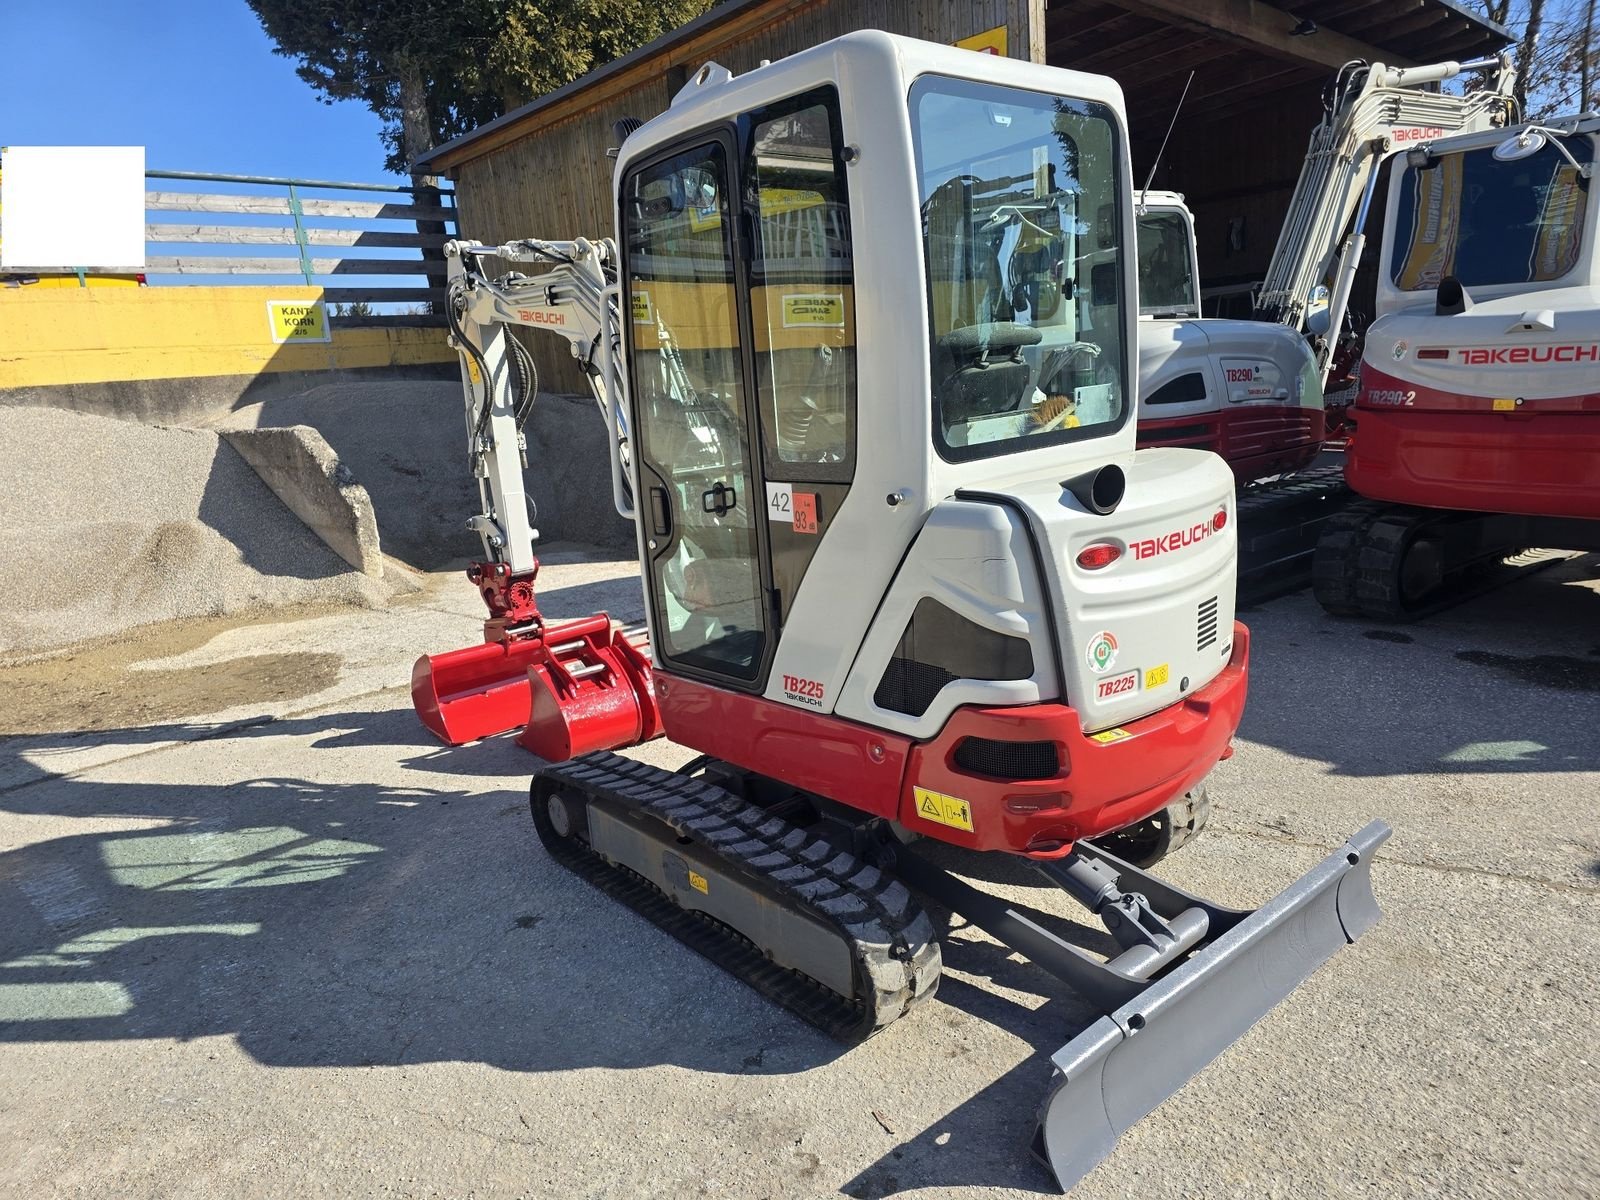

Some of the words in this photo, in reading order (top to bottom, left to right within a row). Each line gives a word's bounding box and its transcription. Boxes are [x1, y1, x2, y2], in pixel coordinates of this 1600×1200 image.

[1392, 127, 1443, 142] TAKEUCHI
[281, 307, 314, 315] KANT-
[517, 310, 565, 325] TAKEUCHI
[284, 318, 315, 326] KORN
[1458, 345, 1600, 365] TAKEUCH
[1226, 368, 1253, 382] TB290
[1367, 390, 1416, 406] TB290-2
[771, 492, 790, 512] 42
[795, 511, 807, 529] 93
[1129, 519, 1213, 560] TAKEUCHI
[783, 675, 824, 699] TB225
[1098, 675, 1135, 698] TB225
[784, 691, 823, 707] TAKEUCHI
